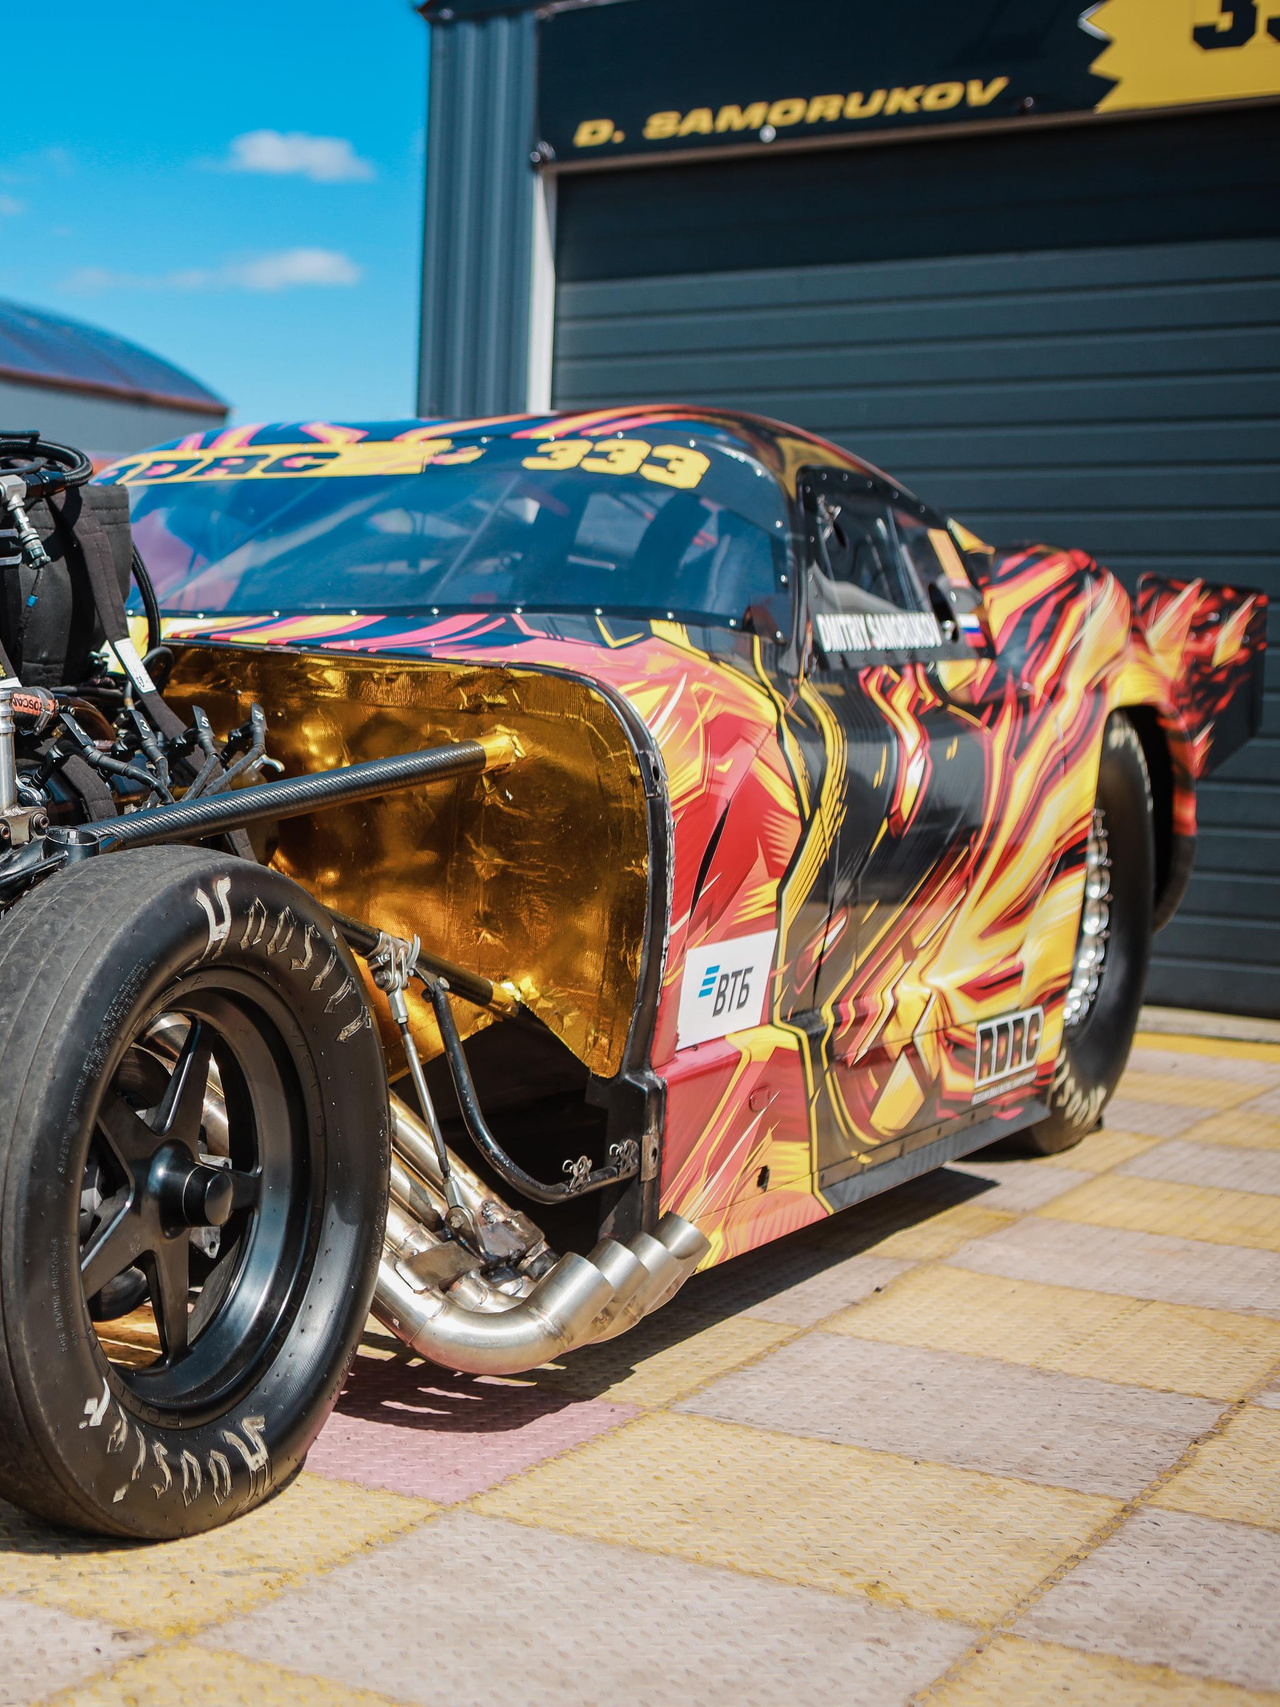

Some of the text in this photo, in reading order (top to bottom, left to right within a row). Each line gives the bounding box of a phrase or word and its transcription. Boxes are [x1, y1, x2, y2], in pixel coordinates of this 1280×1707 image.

[572, 75, 1010, 148] D. SAMORUKOV
[521, 439, 711, 489] 333
[201, 715, 210, 728] 5
[711, 965, 755, 1018] ВТБ
[977, 1010, 1042, 1083] RDRC
